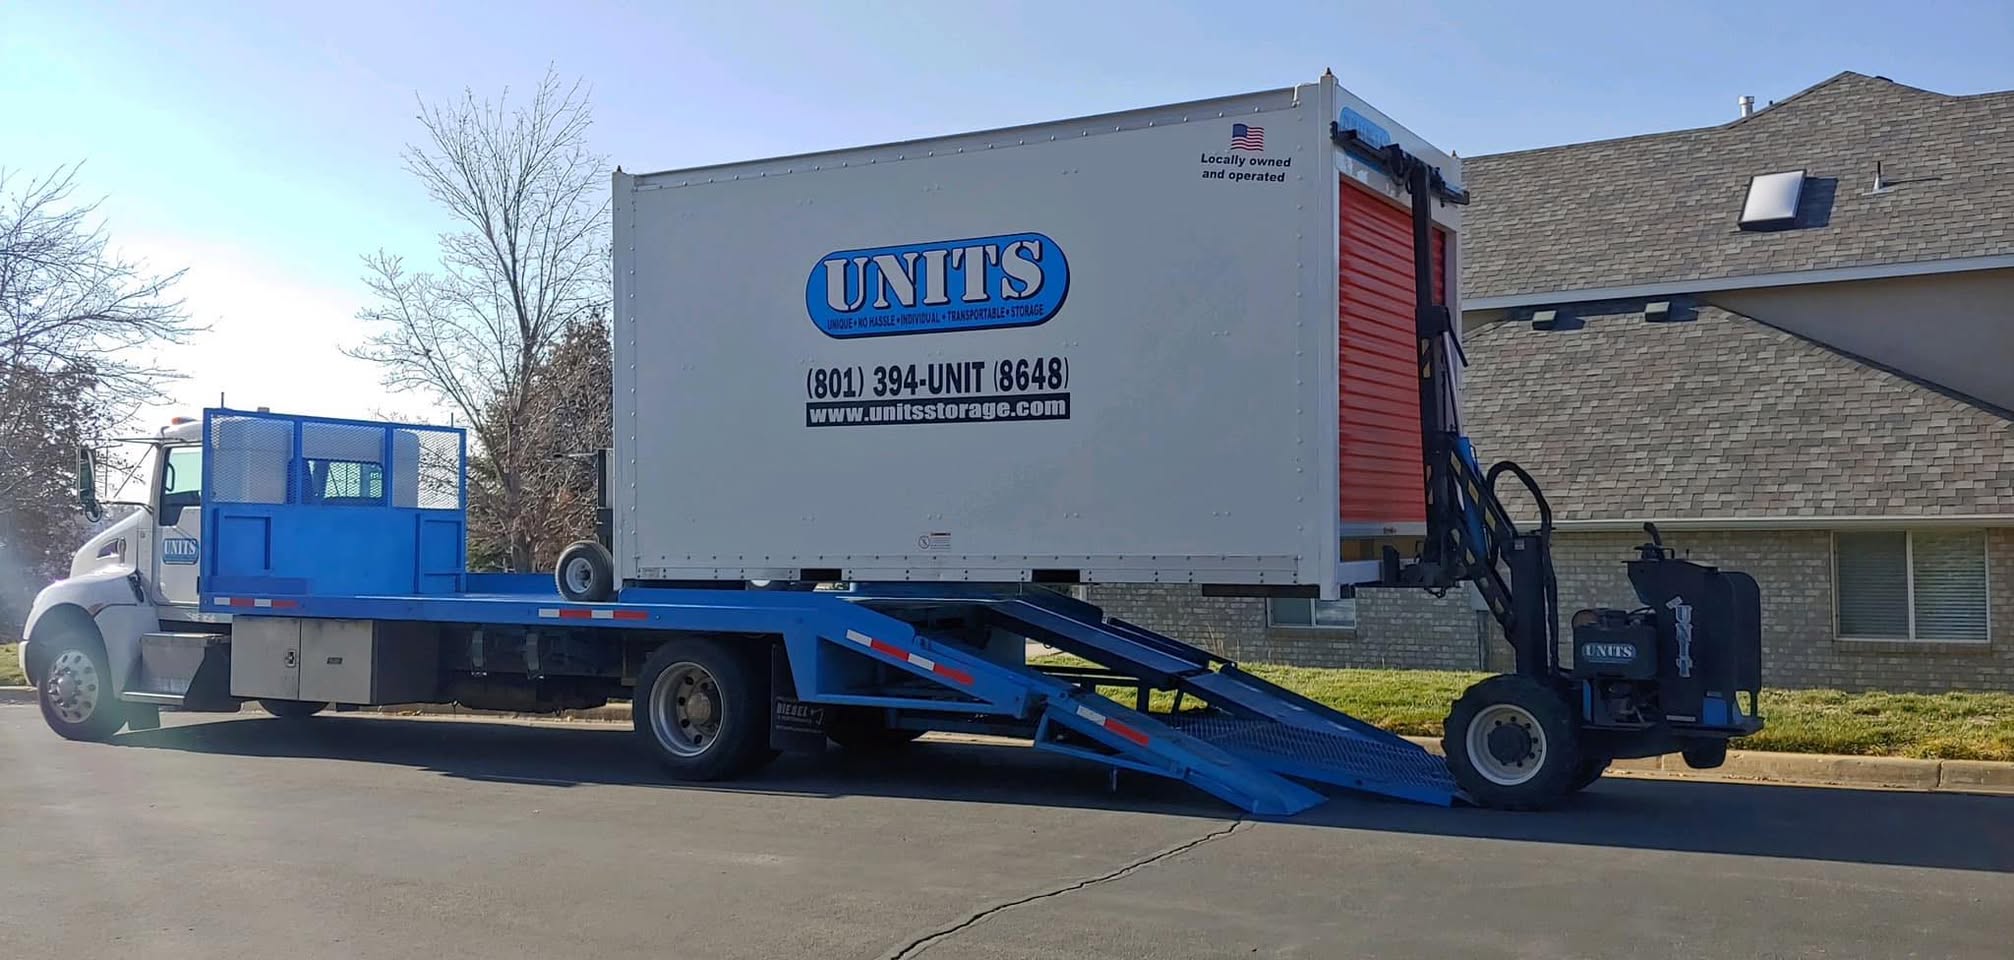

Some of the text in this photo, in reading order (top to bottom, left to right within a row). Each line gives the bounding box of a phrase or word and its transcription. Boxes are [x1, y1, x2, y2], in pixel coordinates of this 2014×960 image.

[1201, 153, 1291, 167] Locally owned
[1202, 169, 1285, 183] and operated
[824, 240, 1044, 313] UNITS
[828, 304, 1044, 330] UNIQUE NO HASSLE INDIVIDUAL TRANSPORTABLE STORAGE
[806, 357, 1069, 399] (801) 394-UNIT (8648)
[809, 399, 1066, 424] www.unitsstorage.com
[164, 540, 196, 555] UNITS
[1585, 644, 1633, 657] UNITS
